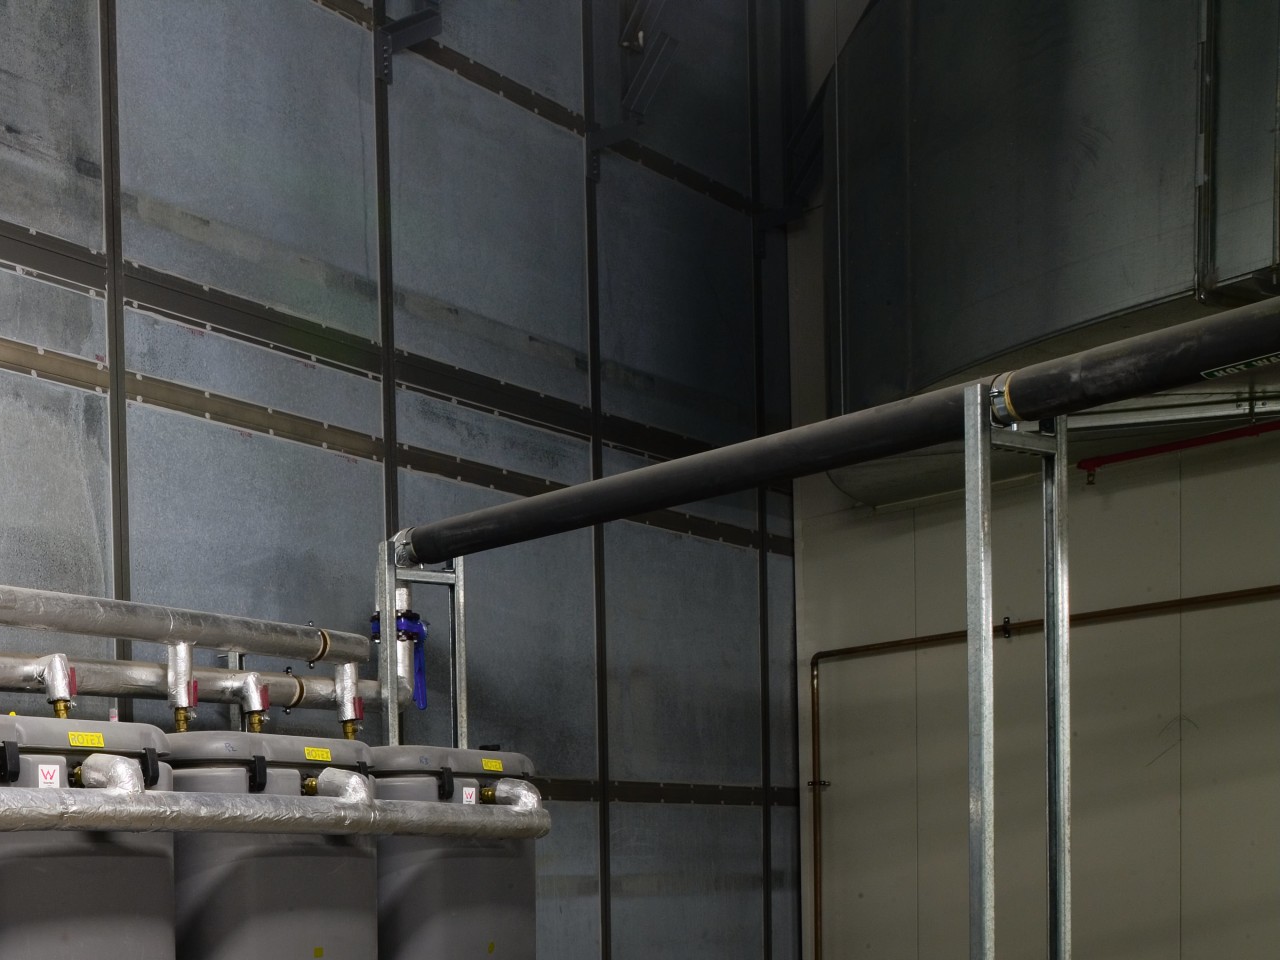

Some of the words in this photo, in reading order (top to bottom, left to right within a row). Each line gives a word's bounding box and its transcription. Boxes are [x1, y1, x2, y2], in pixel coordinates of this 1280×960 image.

[1213, 364, 1248, 377] HOT
[70, 733, 103, 745] ROTEX
[306, 748, 331, 760] ROTEX
